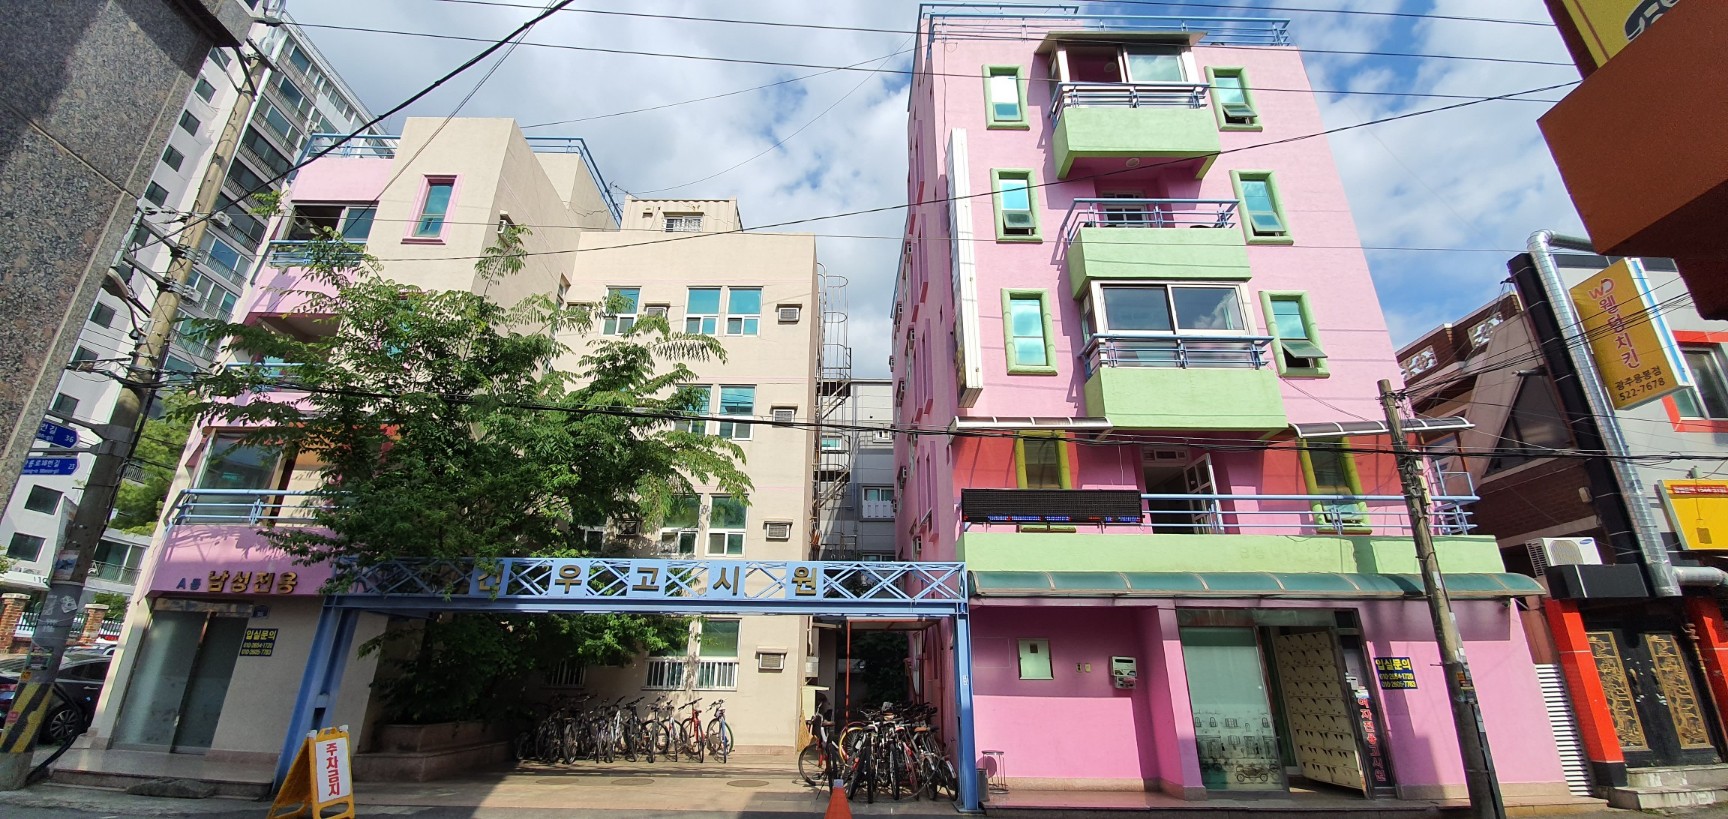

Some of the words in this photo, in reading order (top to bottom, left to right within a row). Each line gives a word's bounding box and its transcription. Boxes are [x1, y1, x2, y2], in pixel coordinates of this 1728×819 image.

[1619, 377, 1666, 401] 522-7678
[208, 570, 298, 593] 남성전용
[245, 629, 277, 640] 입실문의
[1375, 658, 1411, 670] 입실문의
[326, 742, 340, 796] 주차금지
